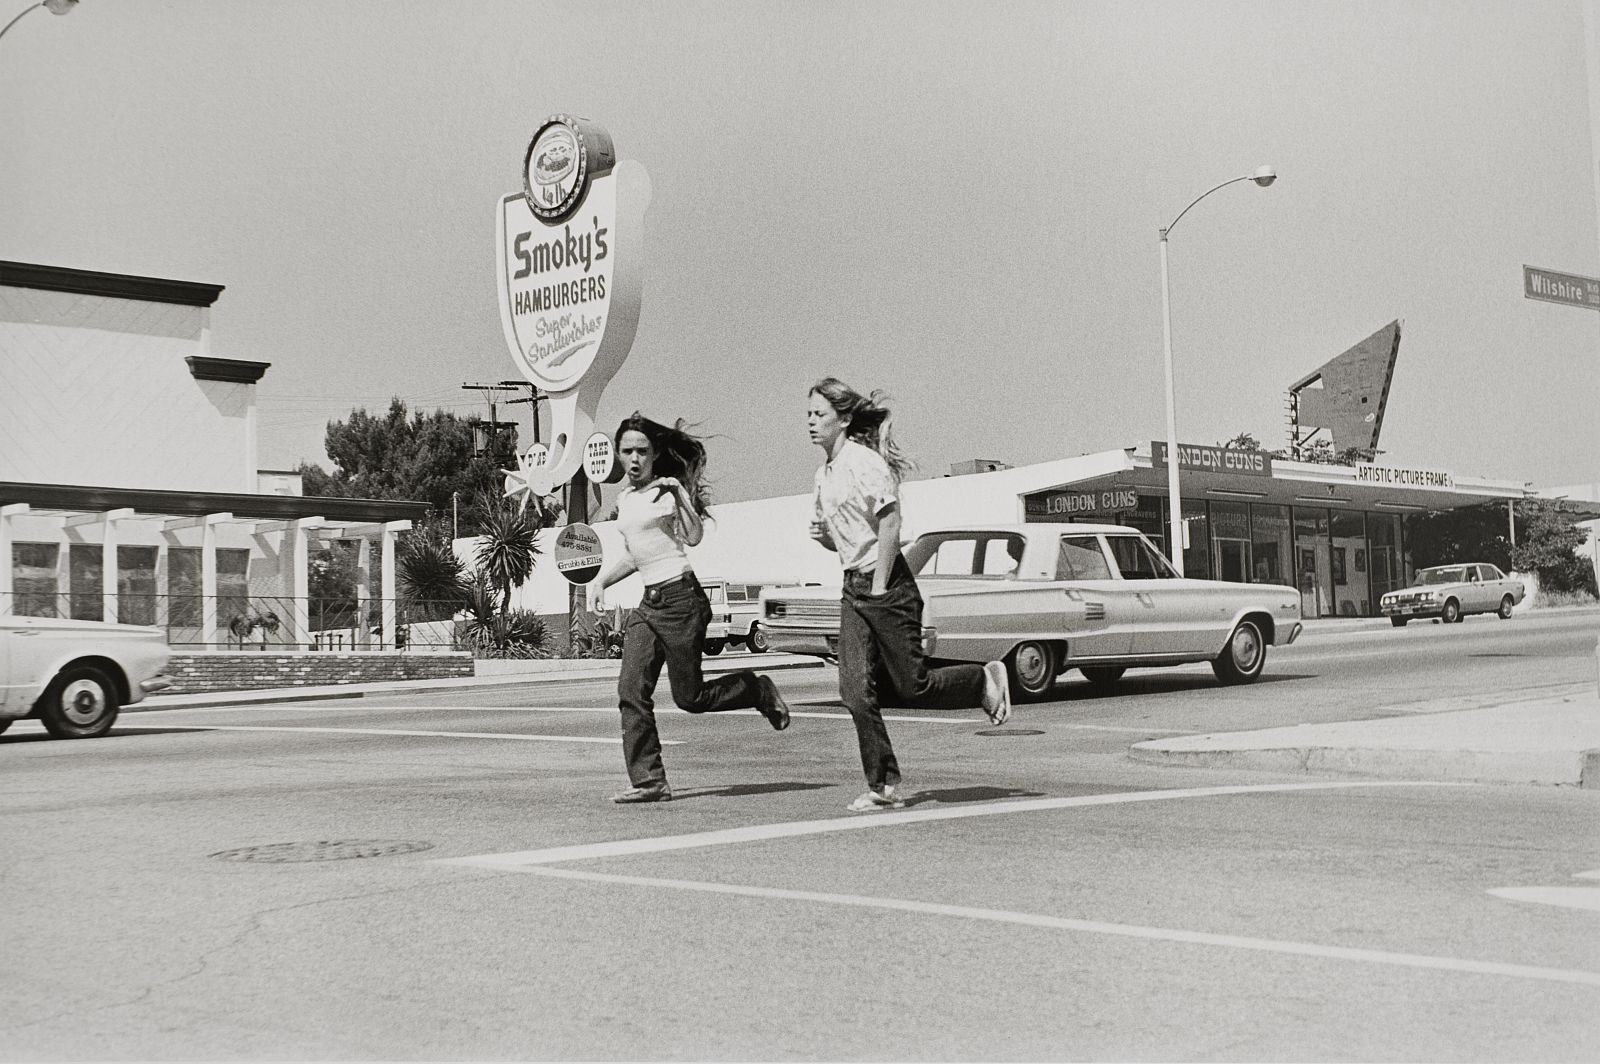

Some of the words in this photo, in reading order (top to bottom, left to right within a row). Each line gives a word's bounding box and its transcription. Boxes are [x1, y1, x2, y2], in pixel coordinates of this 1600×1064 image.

[514, 215, 607, 280] Smoky's
[515, 274, 606, 316] HAMBURGERS
[1530, 273, 1582, 300] Wilshire
[535, 312, 572, 338] Super
[528, 314, 602, 364] Sandwiches
[588, 441, 608, 458] TAKE
[591, 459, 606, 475] OUT
[1225, 452, 1264, 471] GUNS
[1358, 466, 1392, 483] ARTISTIC
[1394, 469, 1424, 486] PICTURE
[1046, 494, 1096, 514] LONDON
[1102, 490, 1137, 509] GUNS
[565, 531, 598, 545] Available
[557, 559, 580, 570] Grubb
[586, 556, 602, 566] Ellis
